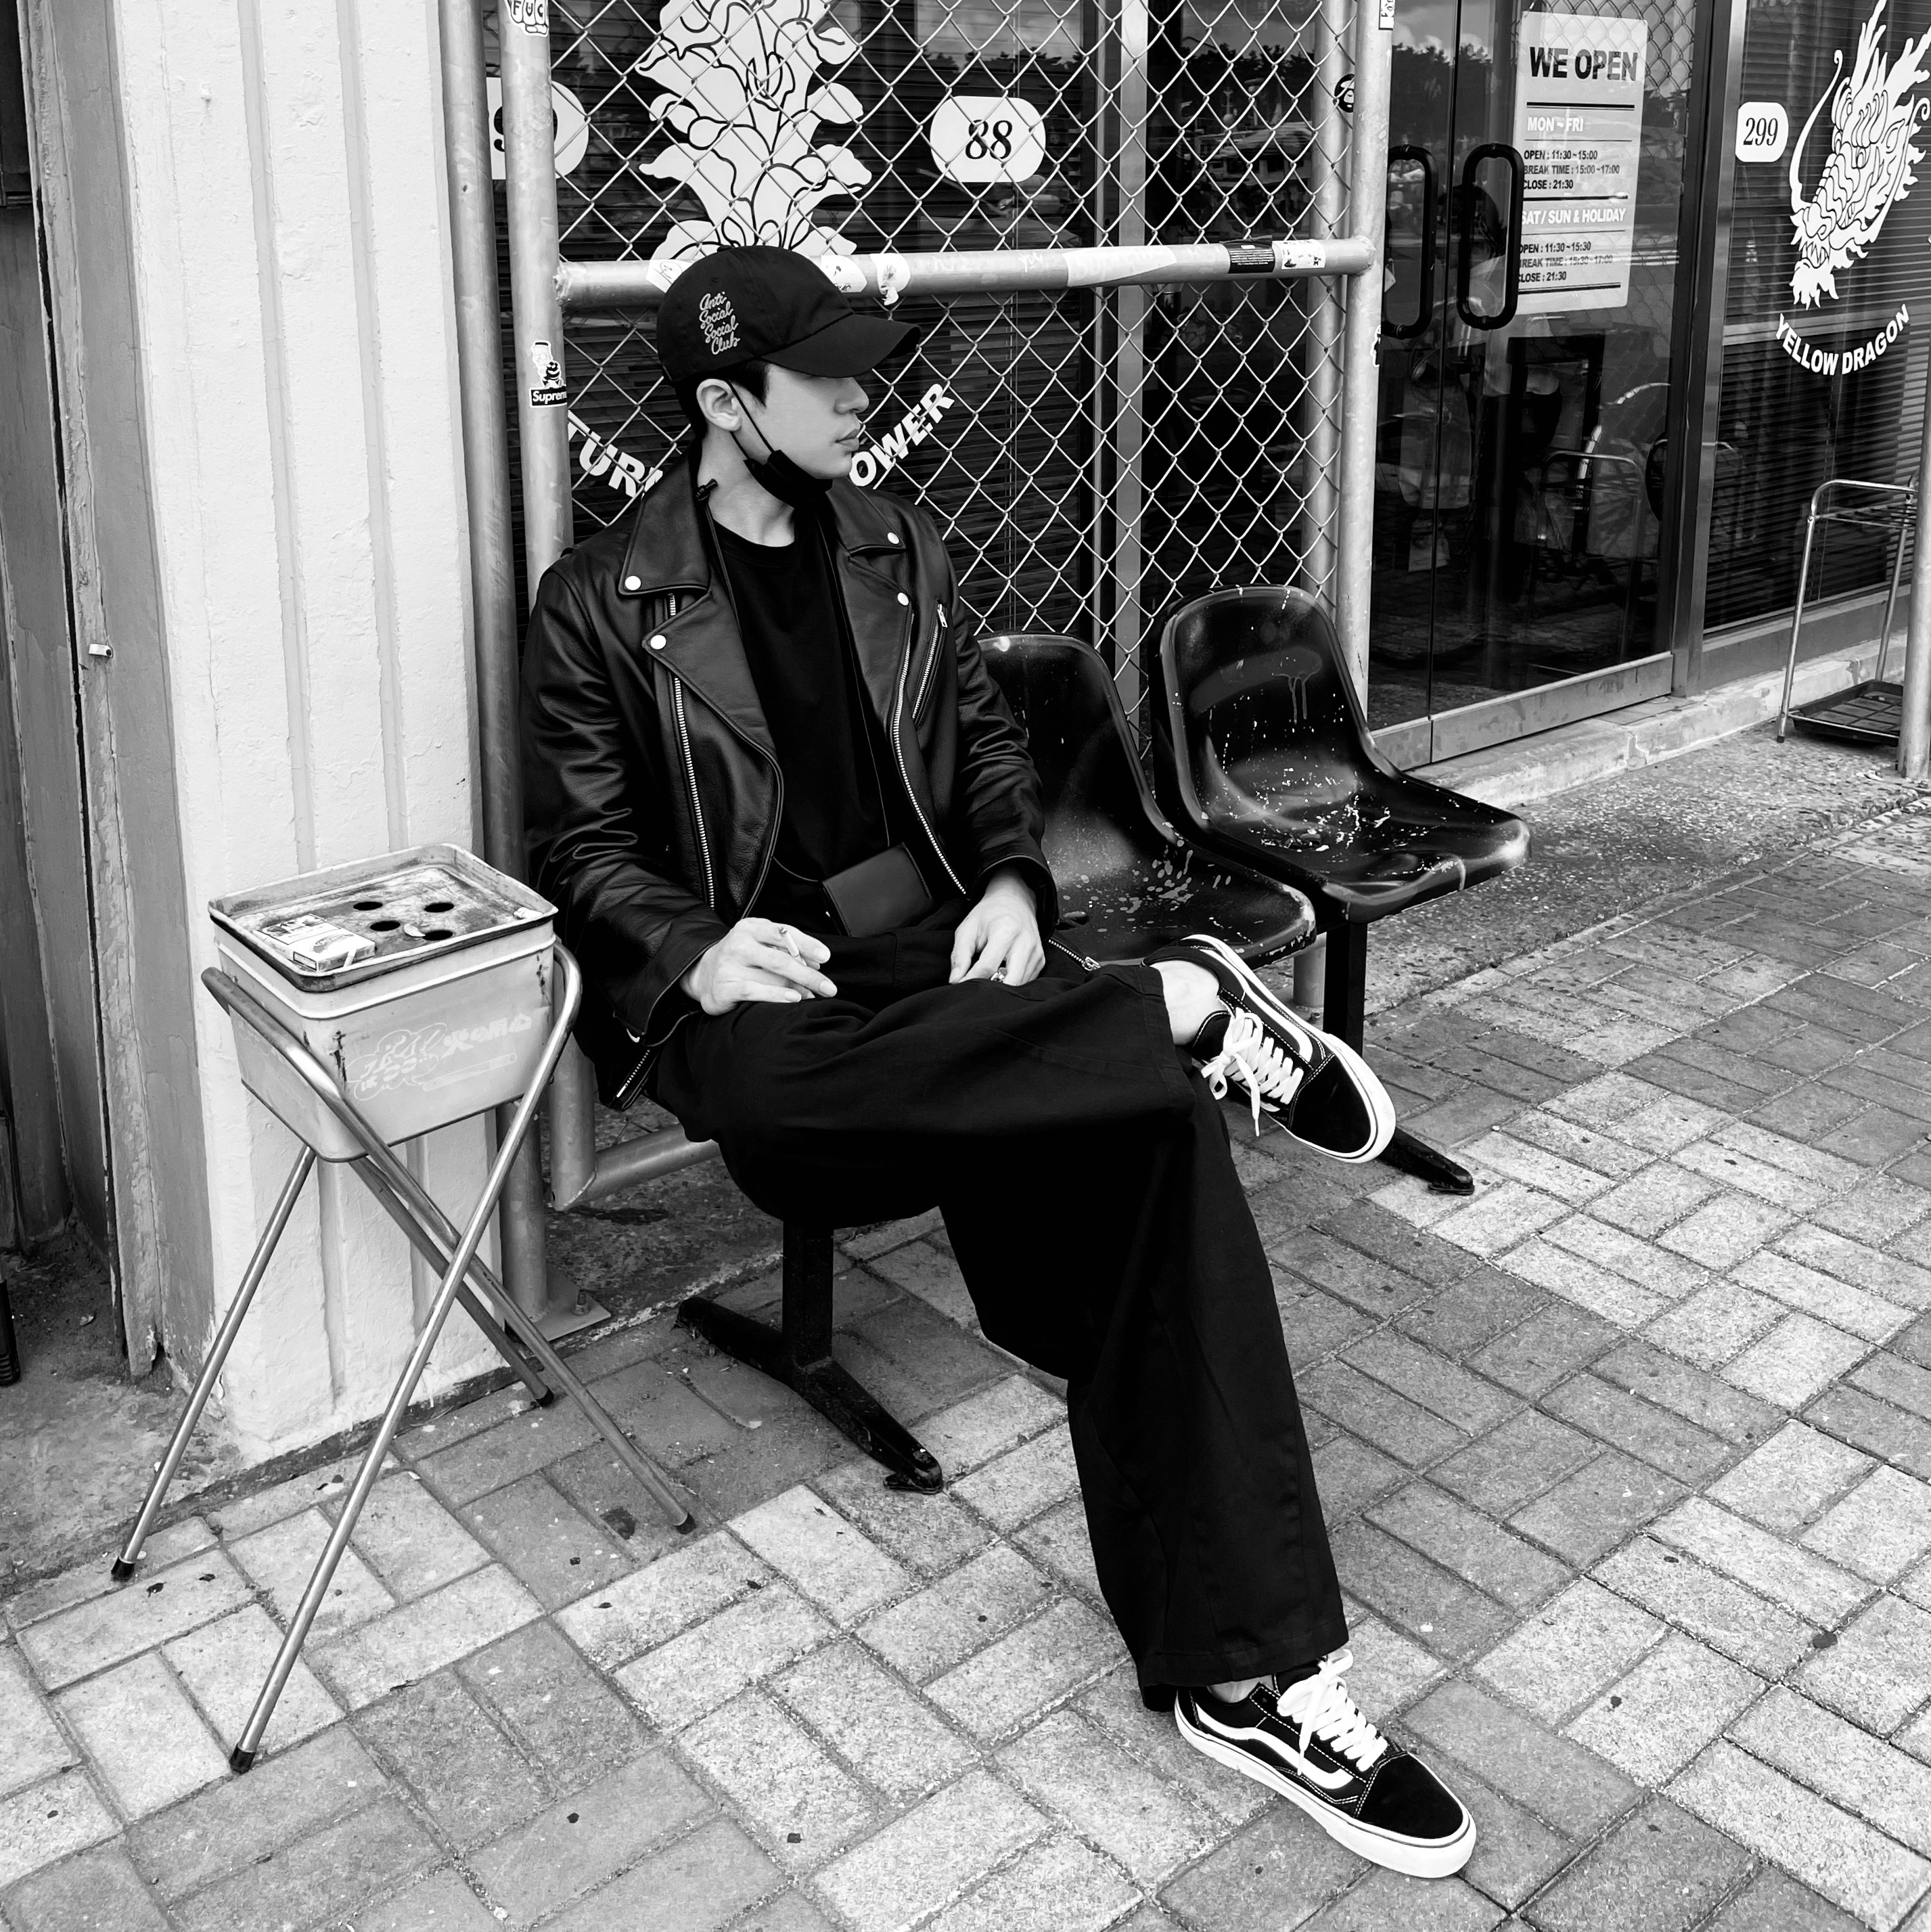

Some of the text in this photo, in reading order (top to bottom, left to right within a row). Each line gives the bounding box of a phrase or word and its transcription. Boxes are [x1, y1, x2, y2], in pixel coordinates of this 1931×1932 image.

[1529, 47, 1638, 81] WE OPEN
[965, 119, 1013, 160] 88
[1743, 117, 1778, 146] 299
[1524, 150, 1545, 160] OPEN
[1523, 165, 1549, 174] BREAK
[1551, 165, 1570, 174] TIME
[1523, 179, 1547, 189] CLOSE
[1553, 179, 1574, 189] 21:30
[1548, 209, 1572, 223] SUN
[1572, 209, 1580, 223] &
[1581, 208, 1626, 223] HOLIDAY
[1520, 258, 1543, 268] REAK
[1546, 271, 1567, 282] 21:30
[699, 291, 727, 311] Anti
[699, 300, 734, 330] Social
[704, 315, 740, 344] Social
[1775, 303, 1910, 376] YELLOW DRAGON
[711, 331, 741, 355] Club
[849, 383, 955, 487] OWER
